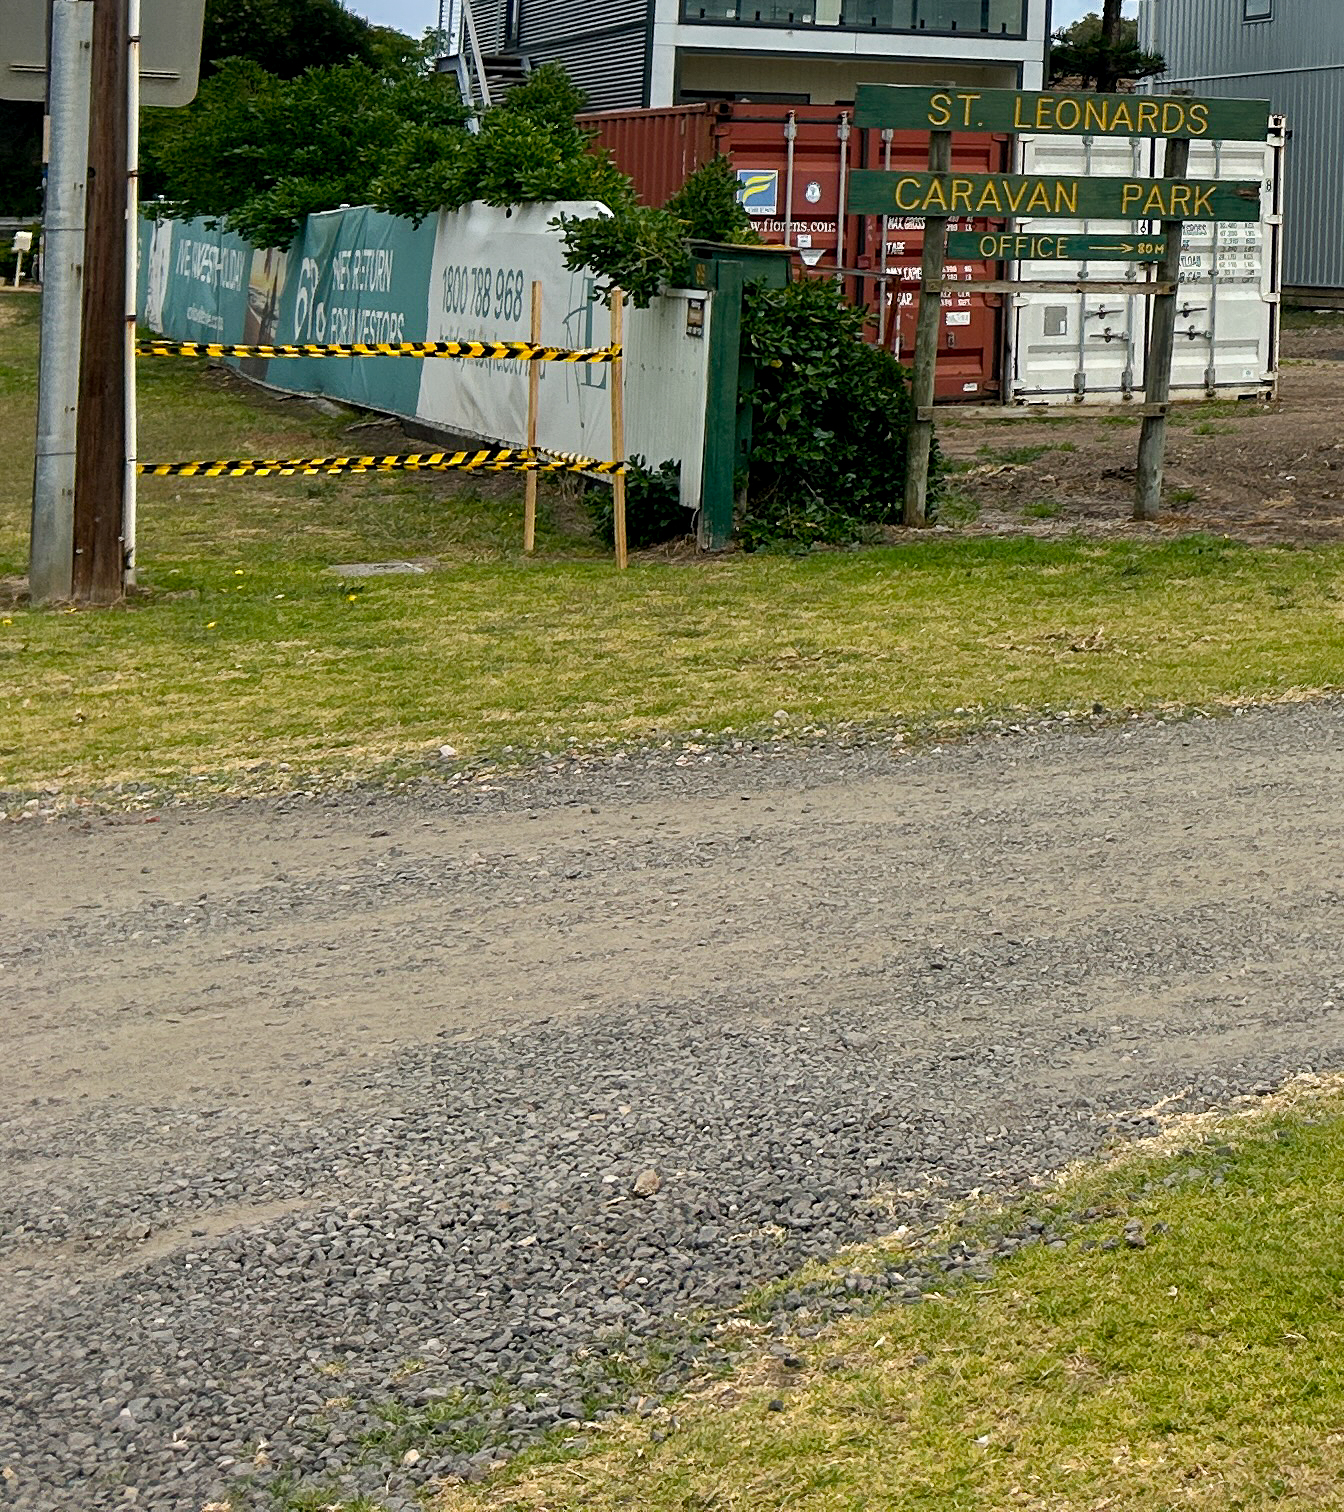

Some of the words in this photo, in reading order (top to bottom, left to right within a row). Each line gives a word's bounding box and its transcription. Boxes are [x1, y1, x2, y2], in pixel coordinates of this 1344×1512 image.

[928, 93, 982, 126] ST.
[1013, 96, 1209, 134] LEONARDS
[894, 177, 1078, 213] CARAVAN
[1121, 184, 1217, 216] PARK
[979, 236, 1070, 259] OFFICE
[352, 249, 393, 292] RETURN
[442, 265, 468, 315] 1800
[470, 267, 492, 318] 788
[495, 269, 524, 323] 968
